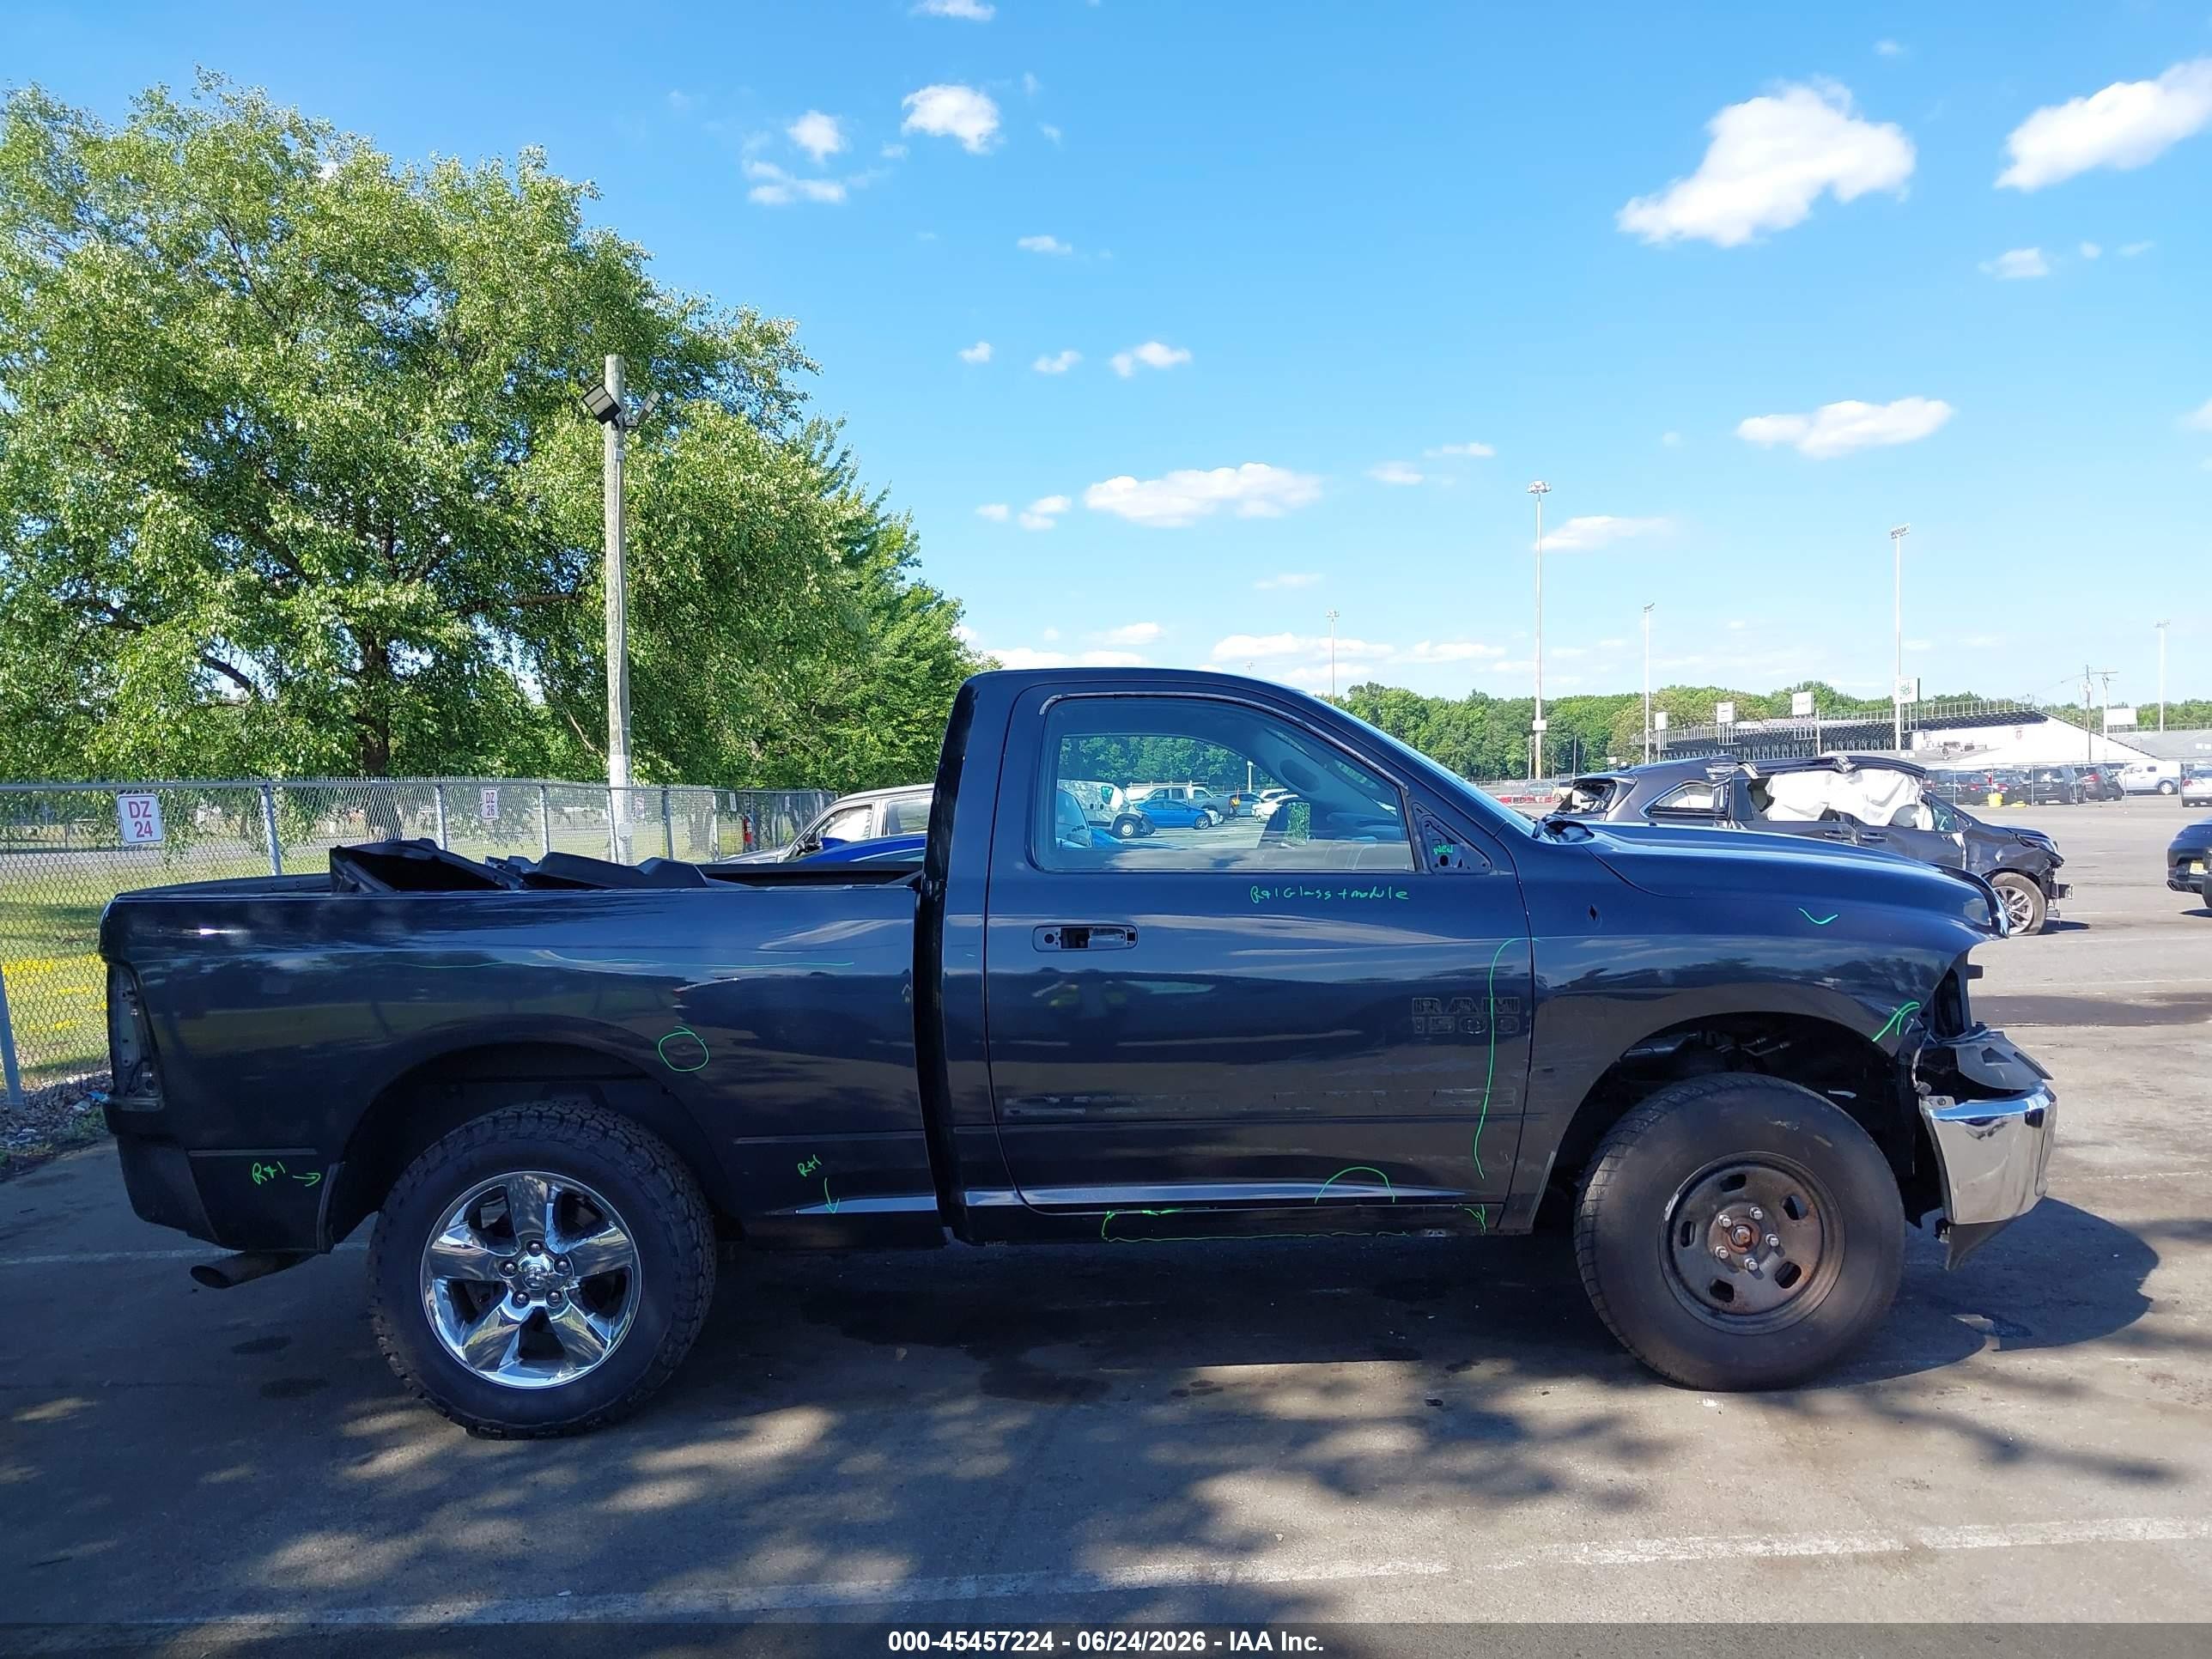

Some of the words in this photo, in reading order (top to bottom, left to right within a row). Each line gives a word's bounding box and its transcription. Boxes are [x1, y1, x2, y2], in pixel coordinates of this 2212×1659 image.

[485, 792, 495, 804] DZ
[128, 800, 152, 819] DZ
[486, 805, 495, 817] 26
[134, 820, 154, 838] 24
[1412, 997, 1520, 1014] RAM
[1412, 1015, 1521, 1035] 1500
